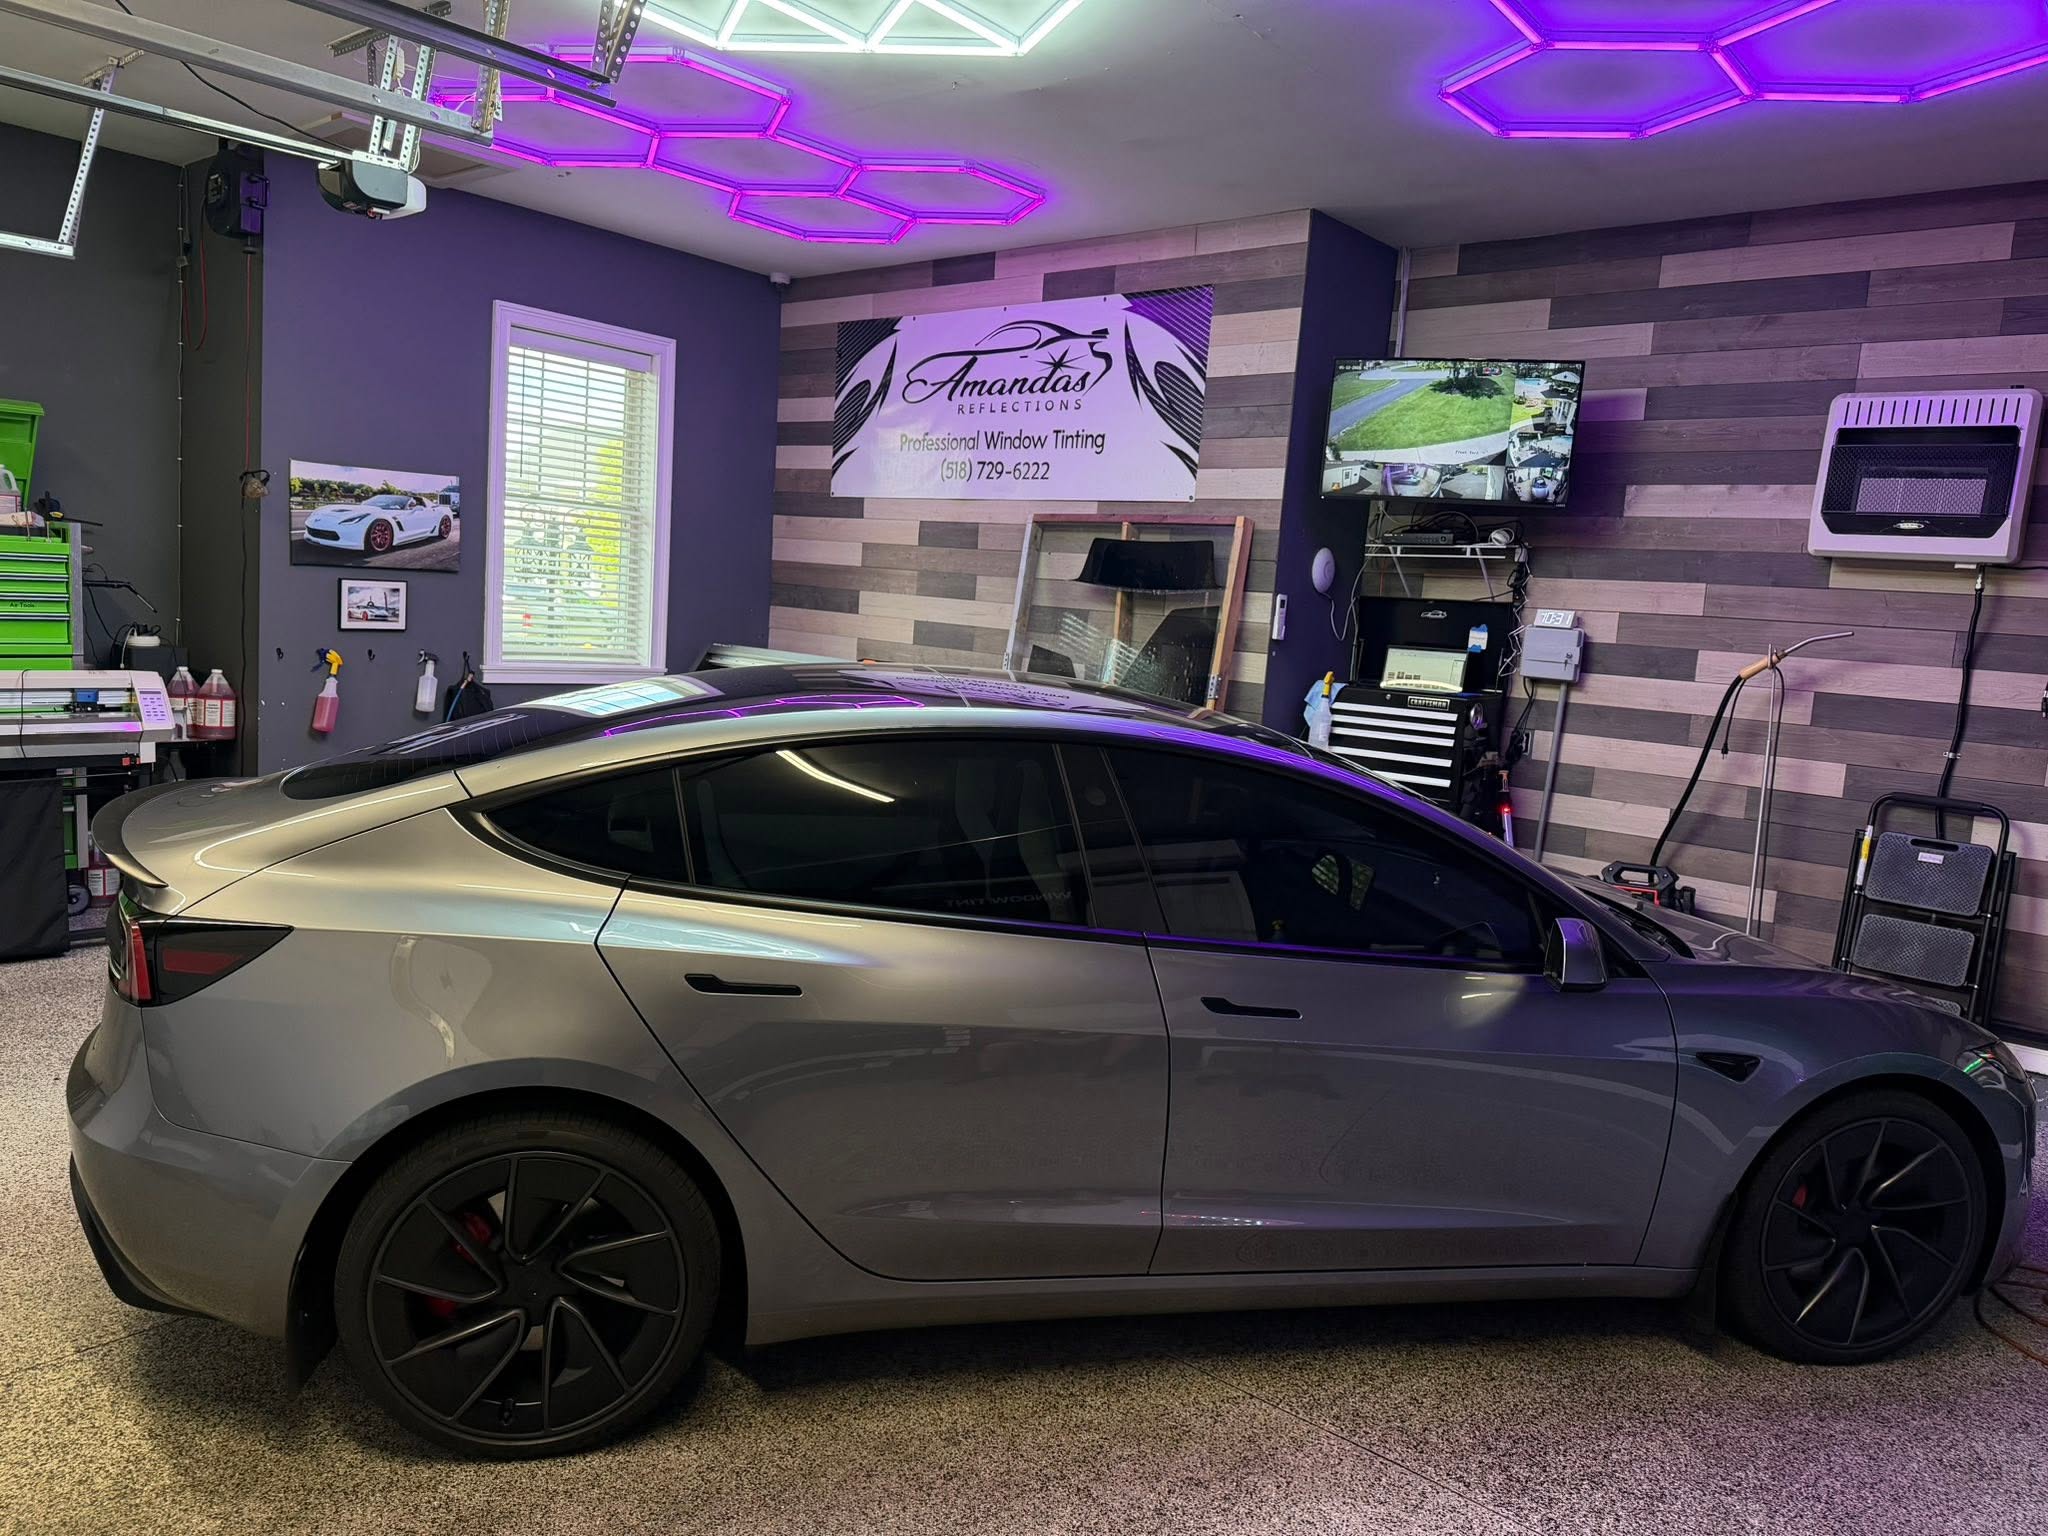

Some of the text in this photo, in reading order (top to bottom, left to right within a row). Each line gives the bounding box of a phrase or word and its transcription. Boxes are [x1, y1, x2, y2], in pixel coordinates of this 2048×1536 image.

[957, 398, 1082, 415] REFLECTIONS
[899, 429, 1106, 455] Professional Window Tinting
[940, 458, 1050, 482] (518) 729-6222
[1410, 698, 1447, 708] CRAFTSMAN
